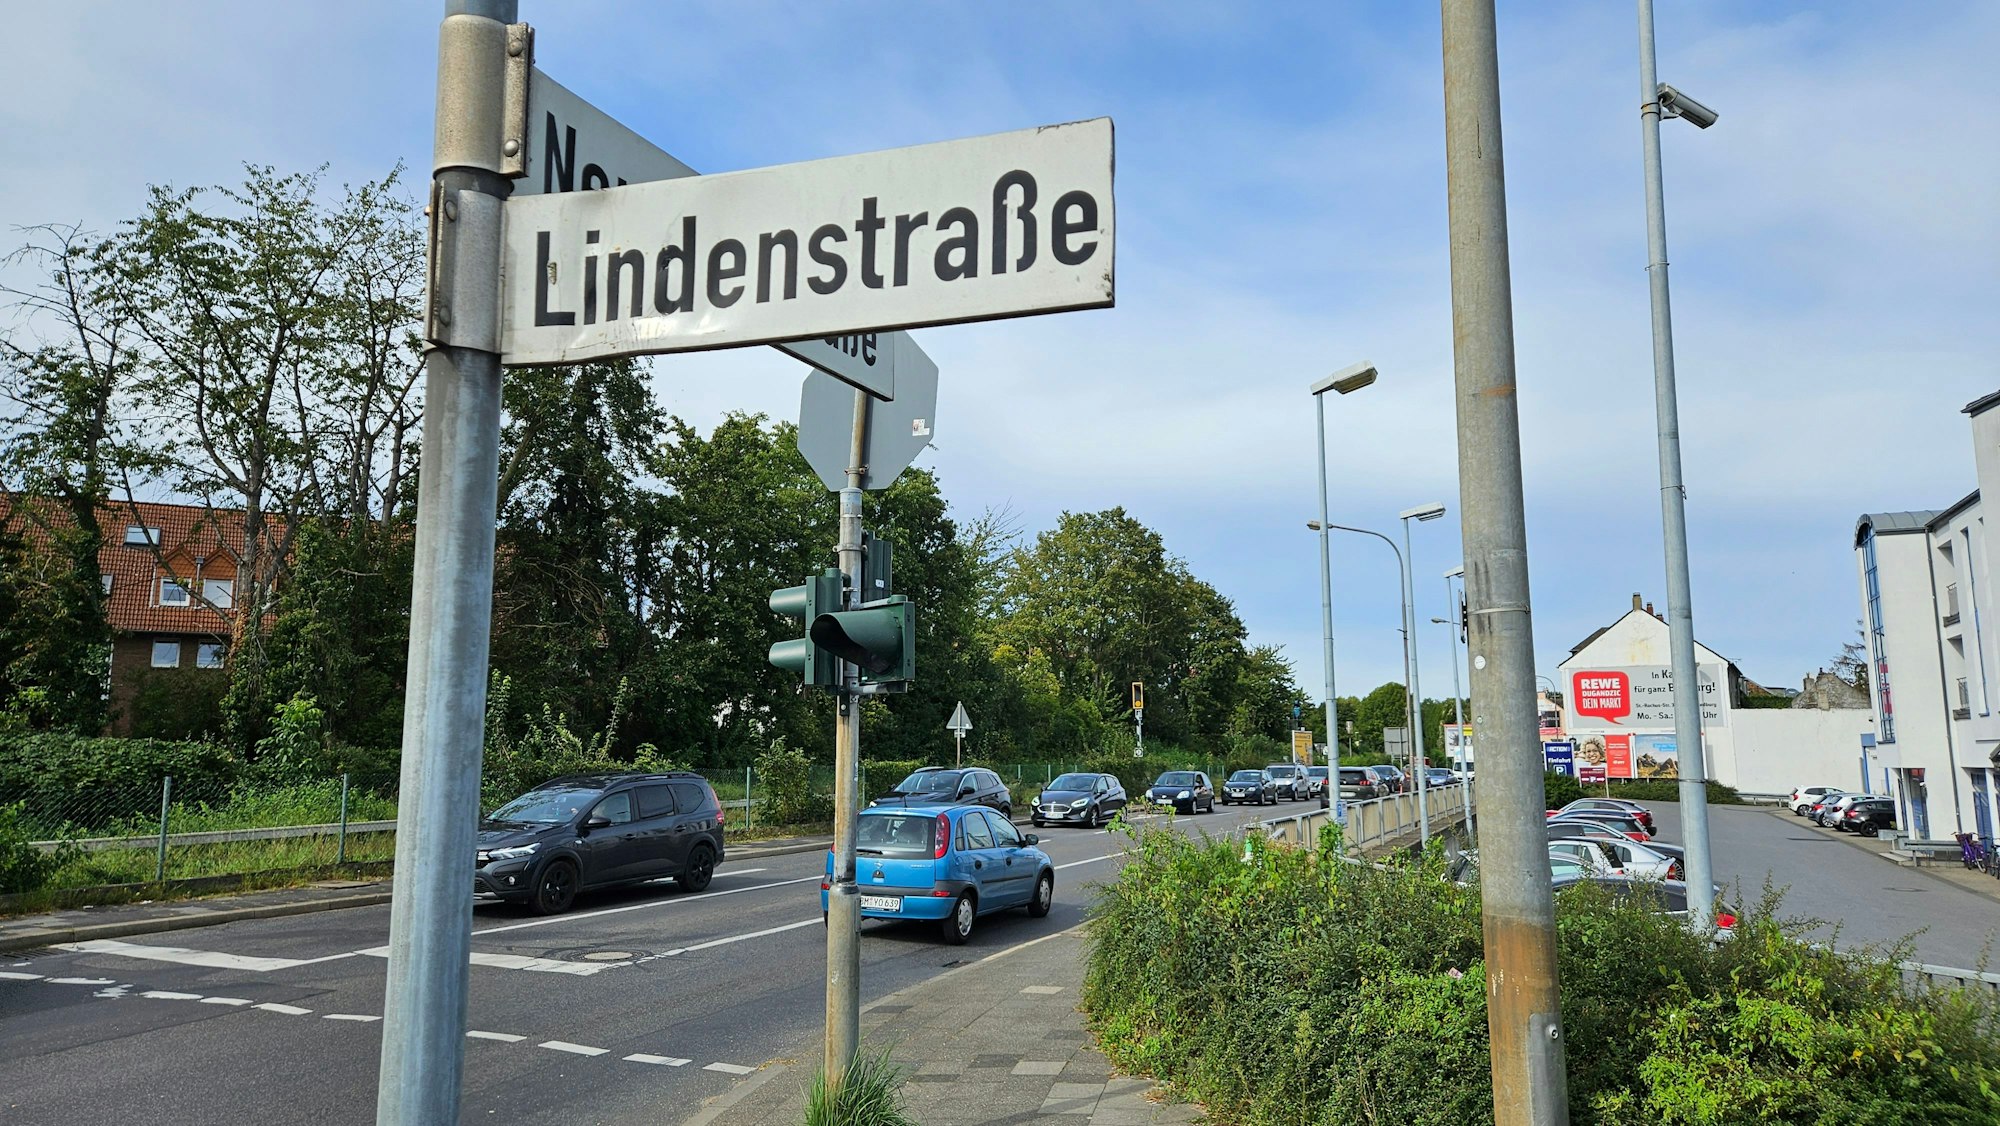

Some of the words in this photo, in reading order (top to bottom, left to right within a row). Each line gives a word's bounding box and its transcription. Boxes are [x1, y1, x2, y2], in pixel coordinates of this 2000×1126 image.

[536, 170, 1098, 326] Lindenstraße
[1651, 671, 1660, 679] In
[1581, 678, 1620, 689] REWE
[1634, 685, 1645, 693] für
[1583, 698, 1598, 708] DEIN
[1600, 697, 1621, 708] MARKT
[1702, 711, 1717, 719] Uhr
[1556, 766, 1564, 776] P
[884, 898, 899, 908] 639
